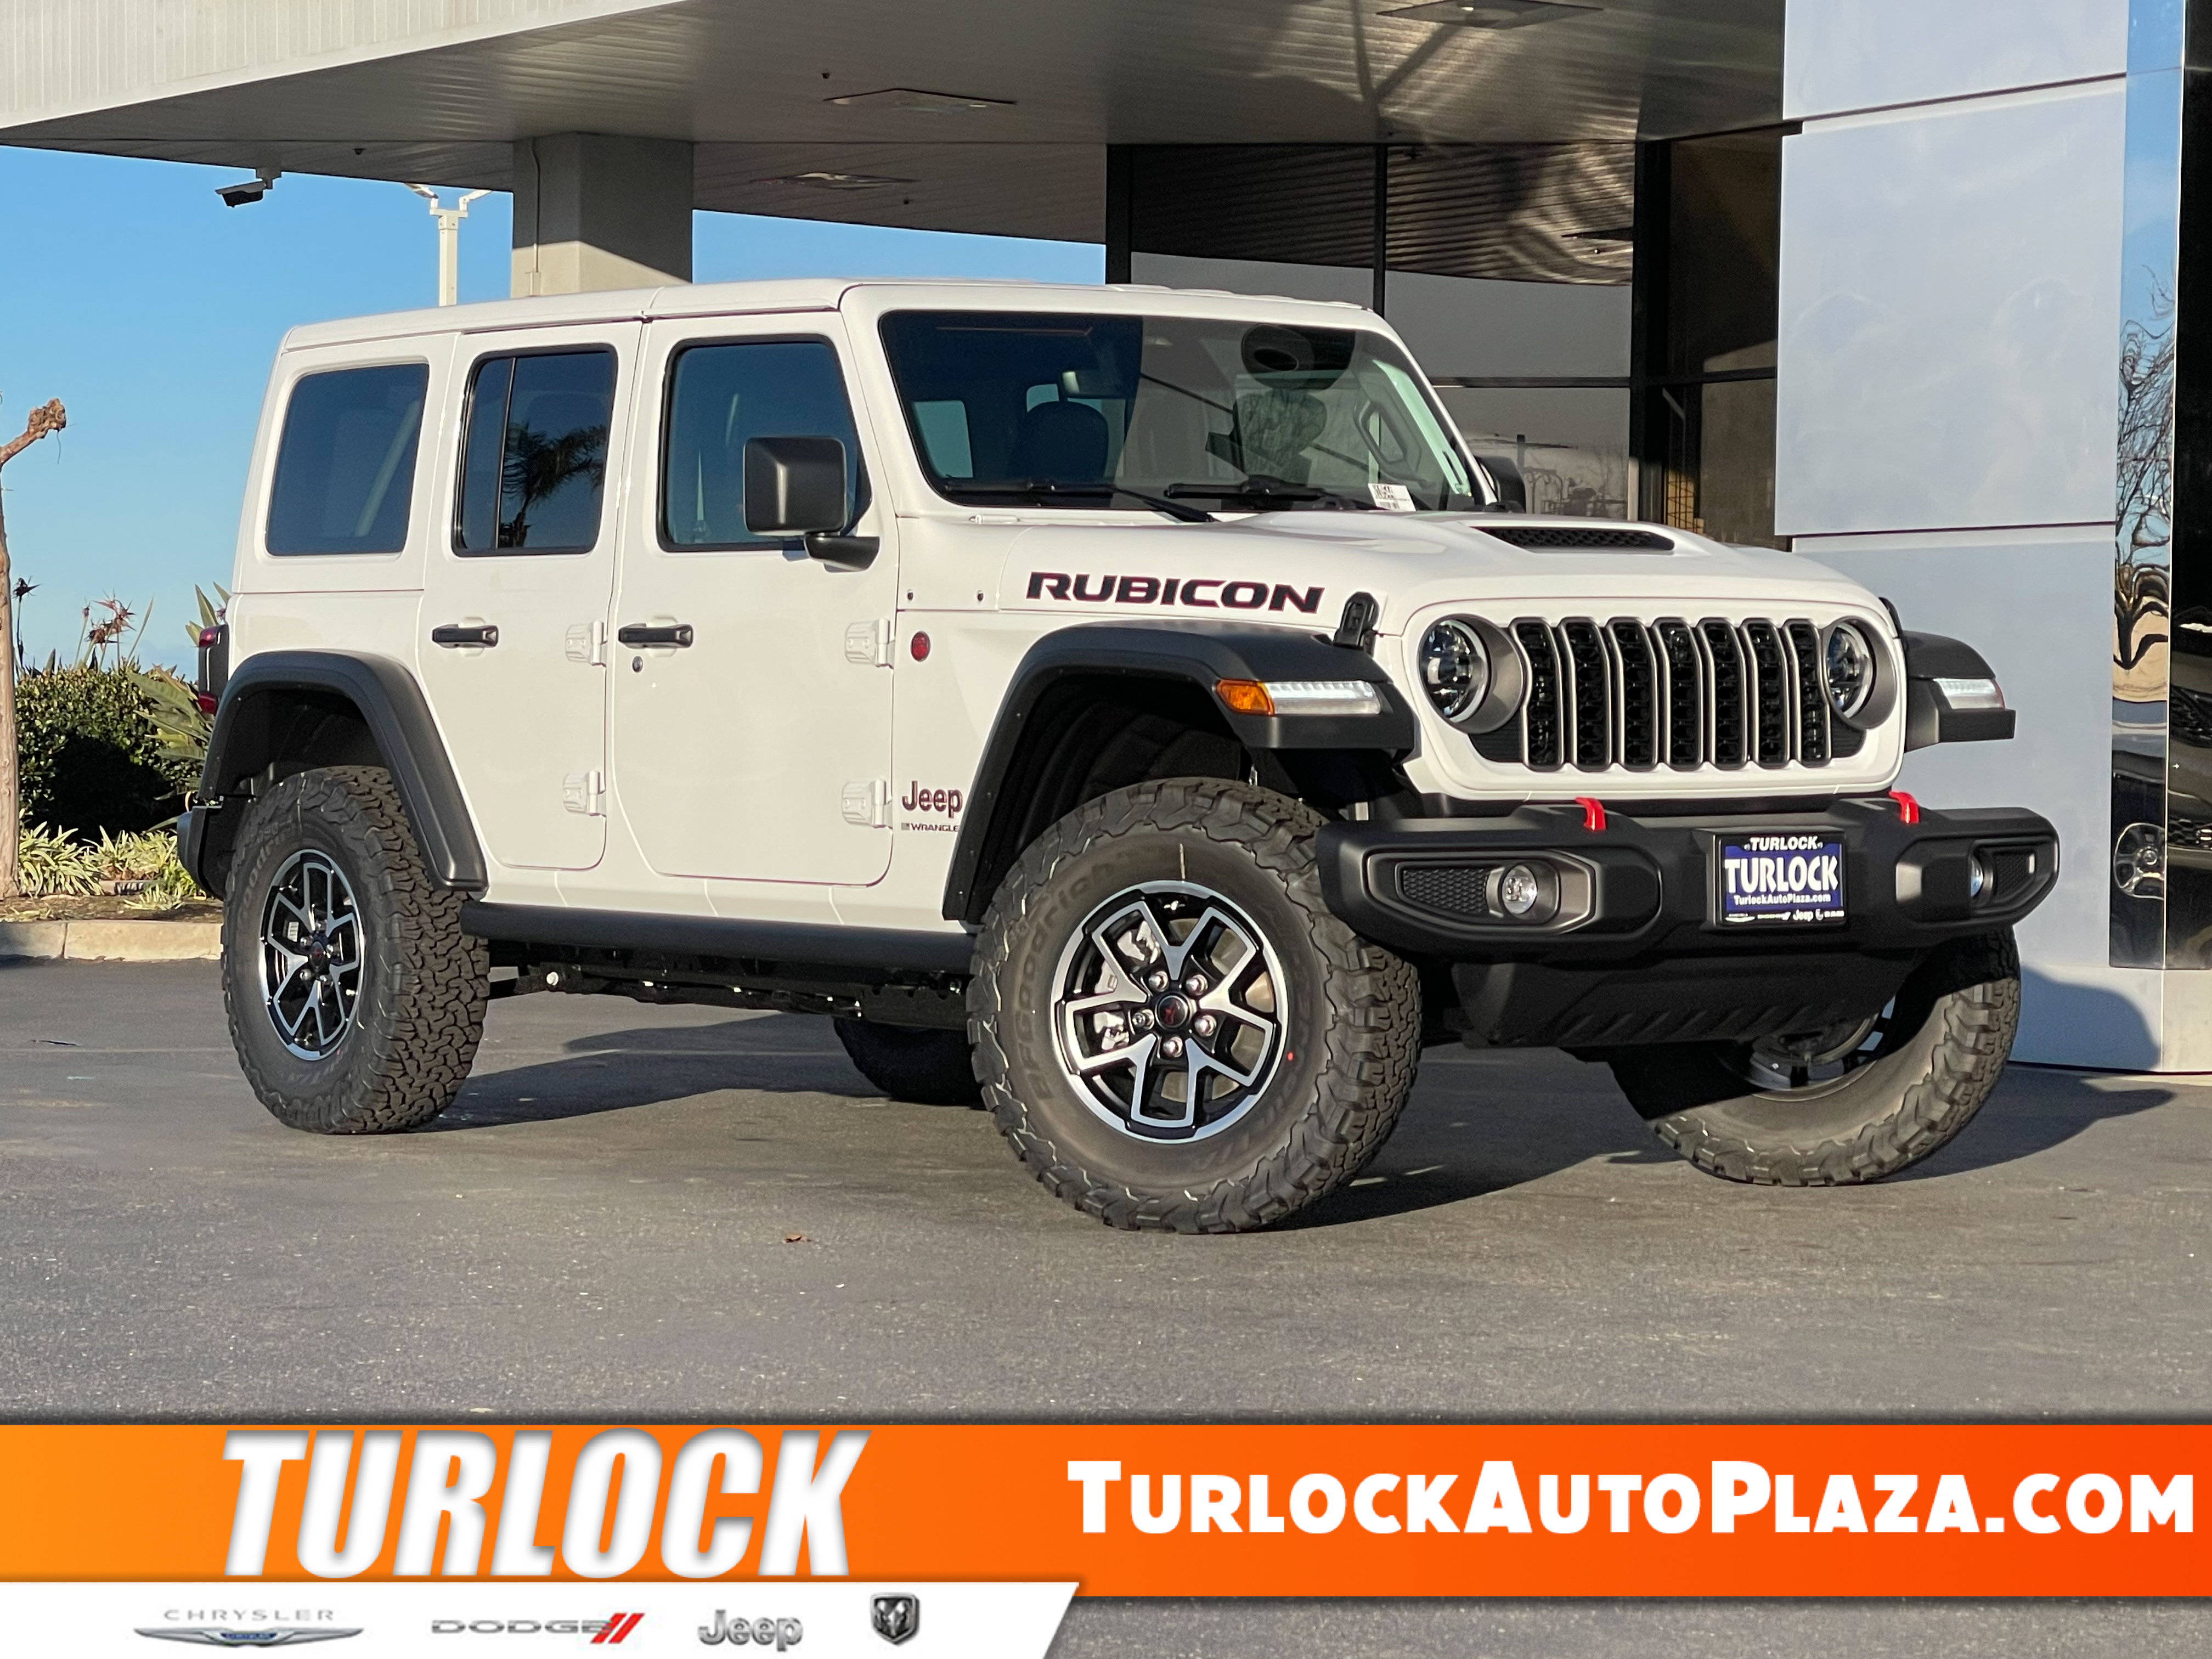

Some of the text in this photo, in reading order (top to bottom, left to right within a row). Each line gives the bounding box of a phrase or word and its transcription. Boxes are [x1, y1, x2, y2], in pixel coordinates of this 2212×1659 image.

[1026, 571, 1325, 614] RUBICON
[902, 780, 963, 819] Jeep
[911, 823, 959, 832] WRANGLE
[1750, 836, 1818, 851] TURLOCK
[1724, 855, 1838, 894] TURLOCK
[1734, 894, 1831, 905] TurlockAutoPlaza.com
[1793, 909, 1813, 922] Jeep
